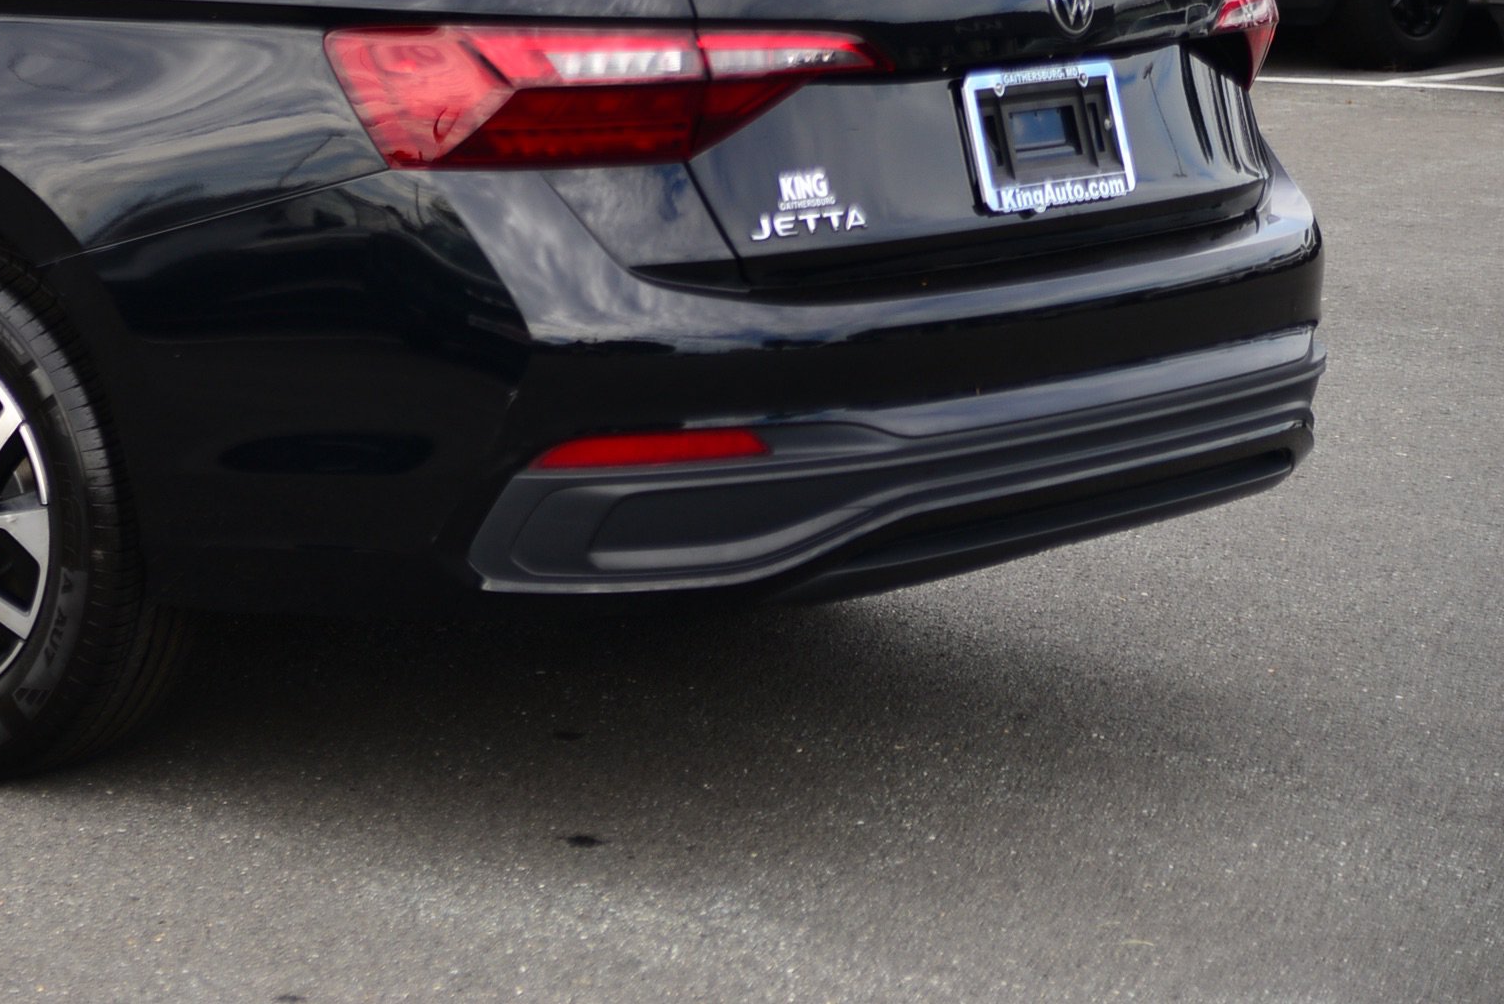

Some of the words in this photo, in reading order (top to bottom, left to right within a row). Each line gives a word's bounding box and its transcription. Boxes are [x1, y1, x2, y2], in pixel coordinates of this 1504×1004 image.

[778, 169, 830, 202] KING
[1000, 178, 1126, 213] KingAuto.com
[750, 206, 868, 241] JETTA
